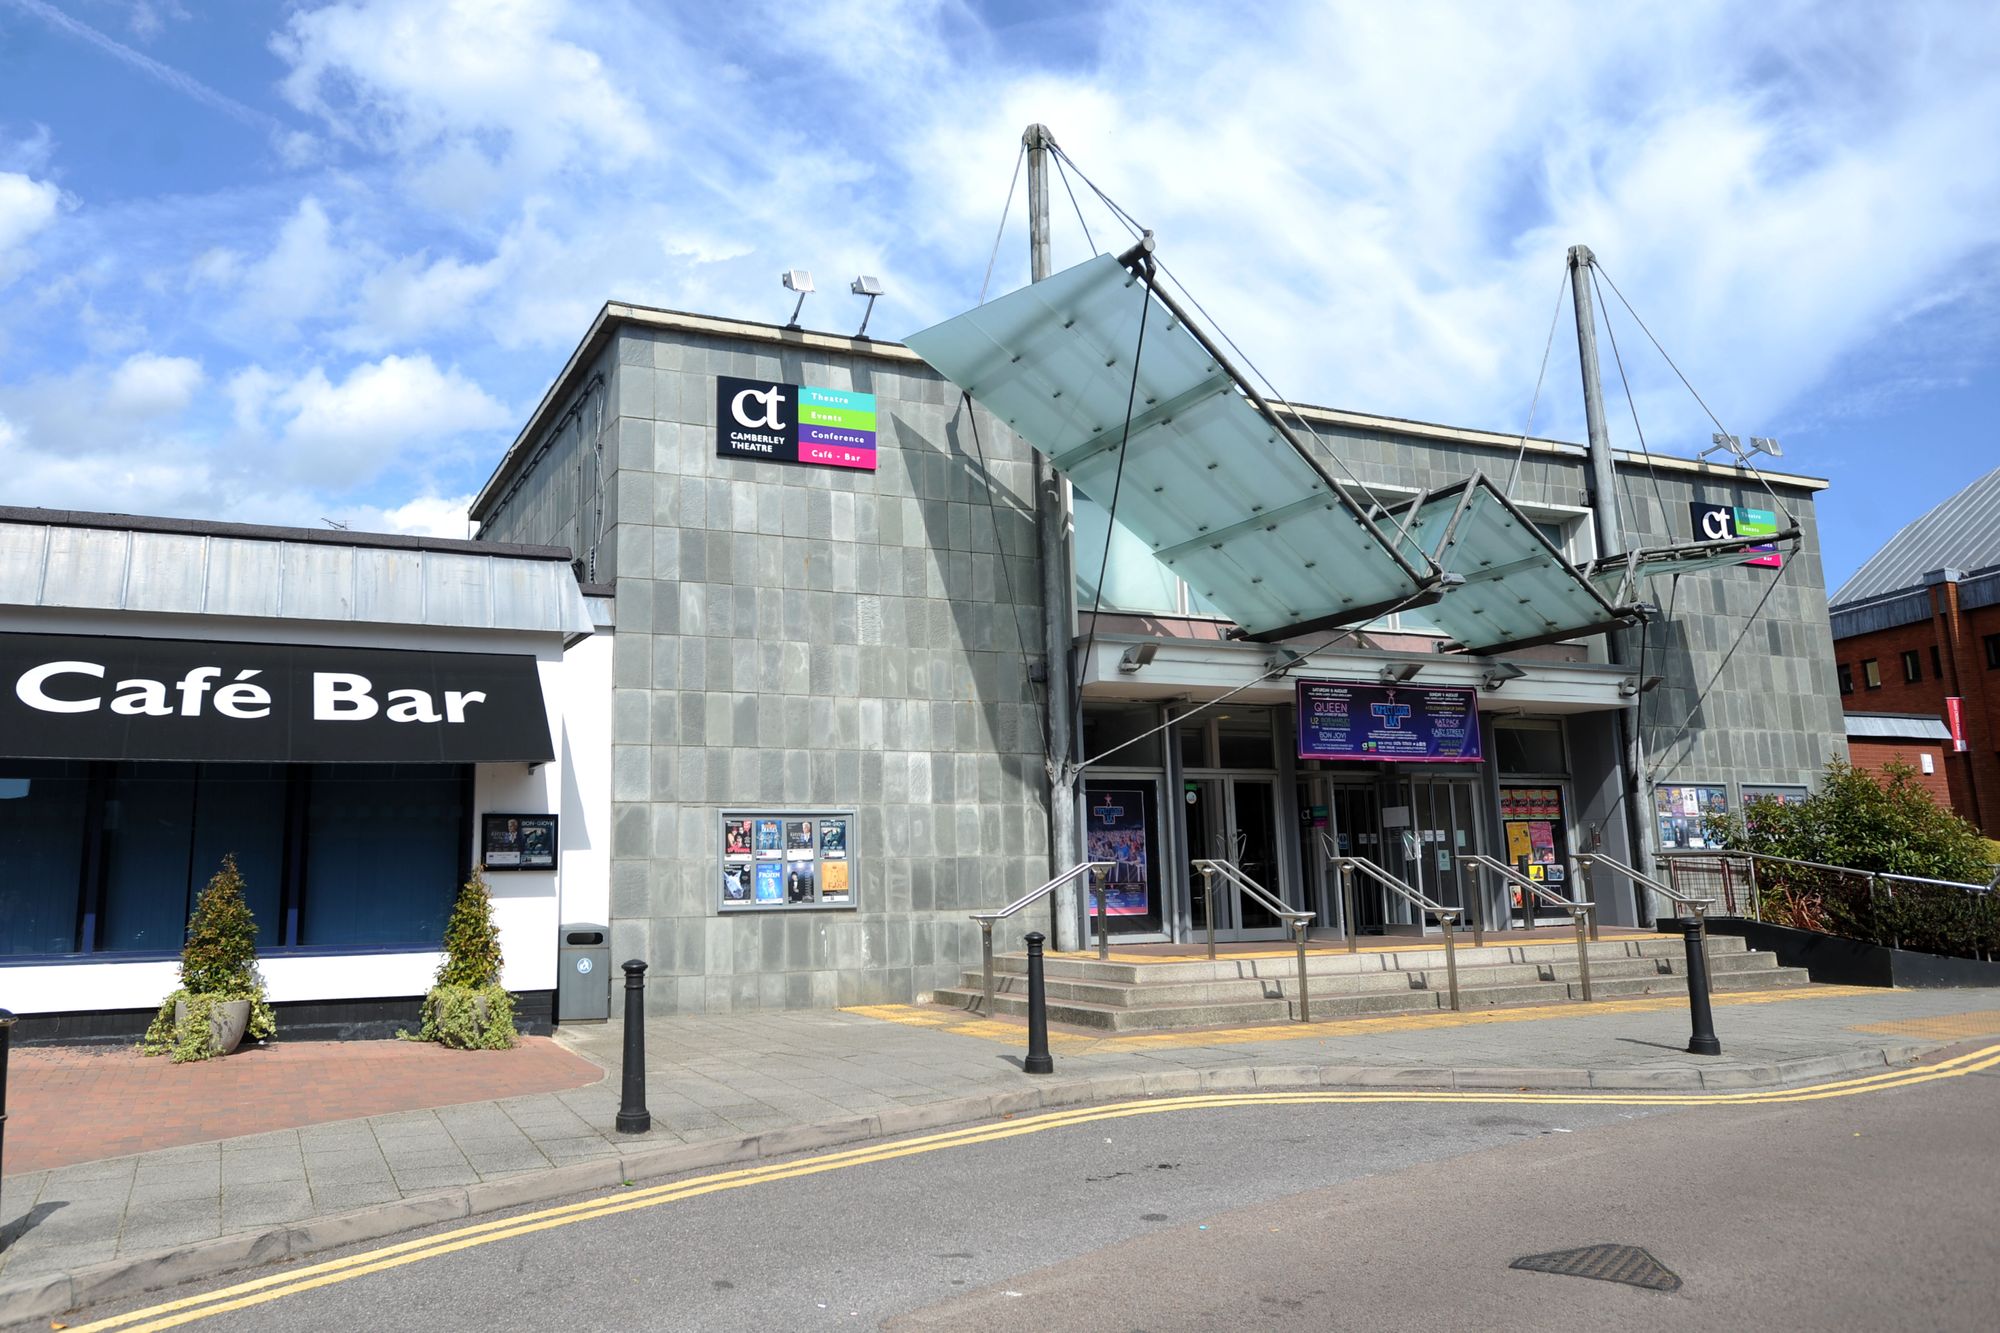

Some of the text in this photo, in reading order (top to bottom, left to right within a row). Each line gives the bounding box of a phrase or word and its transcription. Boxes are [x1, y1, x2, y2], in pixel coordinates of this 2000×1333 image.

[811, 392, 849, 404] Theatre
[731, 385, 786, 430] ct
[811, 411, 842, 422] Events
[730, 431, 786, 445] CAMBERLEY
[811, 430, 865, 444] Conference
[731, 441, 773, 453] THEATRE
[844, 452, 861, 462] Bar
[1741, 512, 1761, 520] Theatre
[15, 660, 487, 723] Café Bar
[1314, 702, 1348, 713] QUEEN
[1319, 731, 1332, 739] BON
